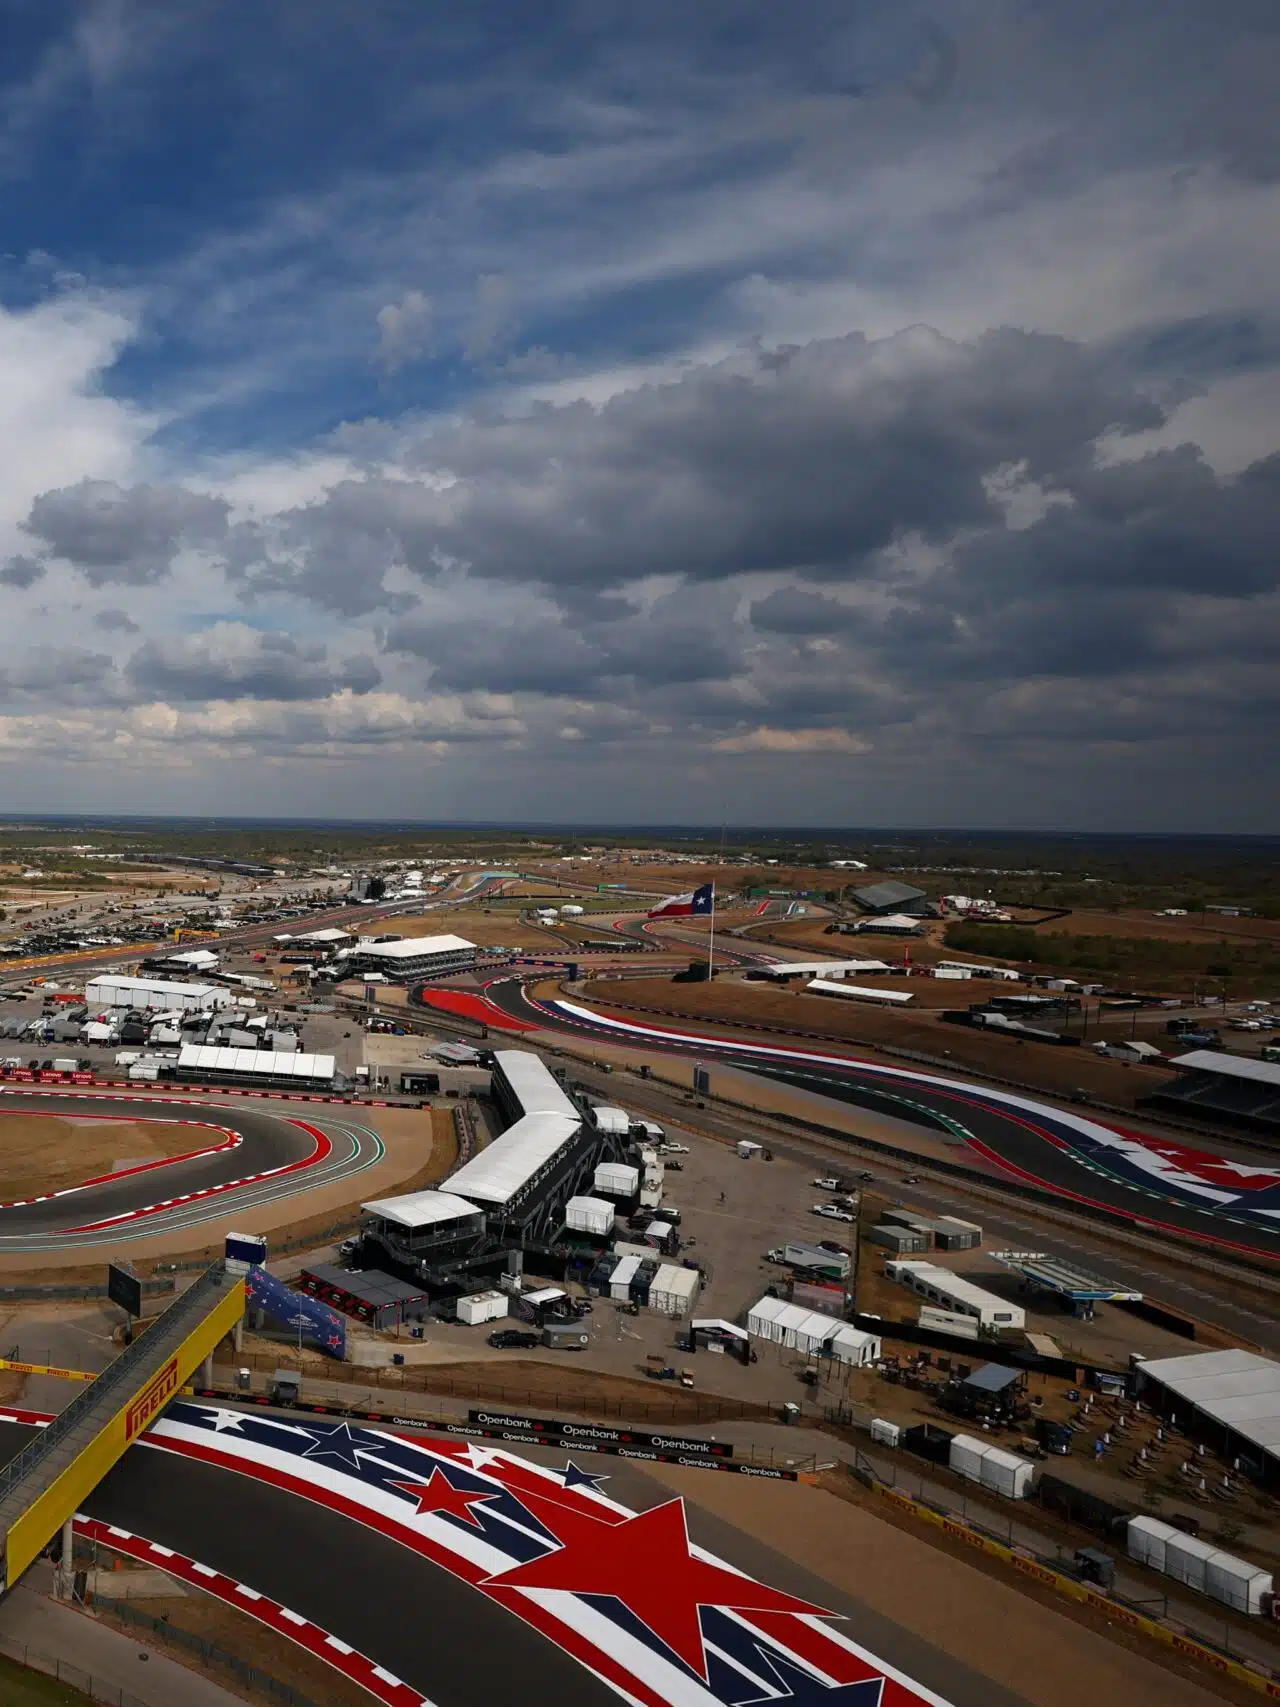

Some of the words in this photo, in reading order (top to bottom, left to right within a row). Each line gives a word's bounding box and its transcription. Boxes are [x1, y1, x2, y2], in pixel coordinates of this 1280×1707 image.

[72, 1072, 92, 1080] Lenovo
[126, 1358, 178, 1441] PIRELLI
[478, 1414, 532, 1429] Openbank
[562, 1424, 619, 1440] Openbank
[393, 1417, 428, 1428] Openbank
[447, 1424, 483, 1436] Openbank
[502, 1432, 540, 1444] Openbank
[560, 1440, 598, 1451] Openbank
[618, 1448, 657, 1460] Openbank
[678, 1456, 718, 1470] Openbank
[740, 1466, 782, 1478] Openbank
[652, 1436, 710, 1453] Openbank
